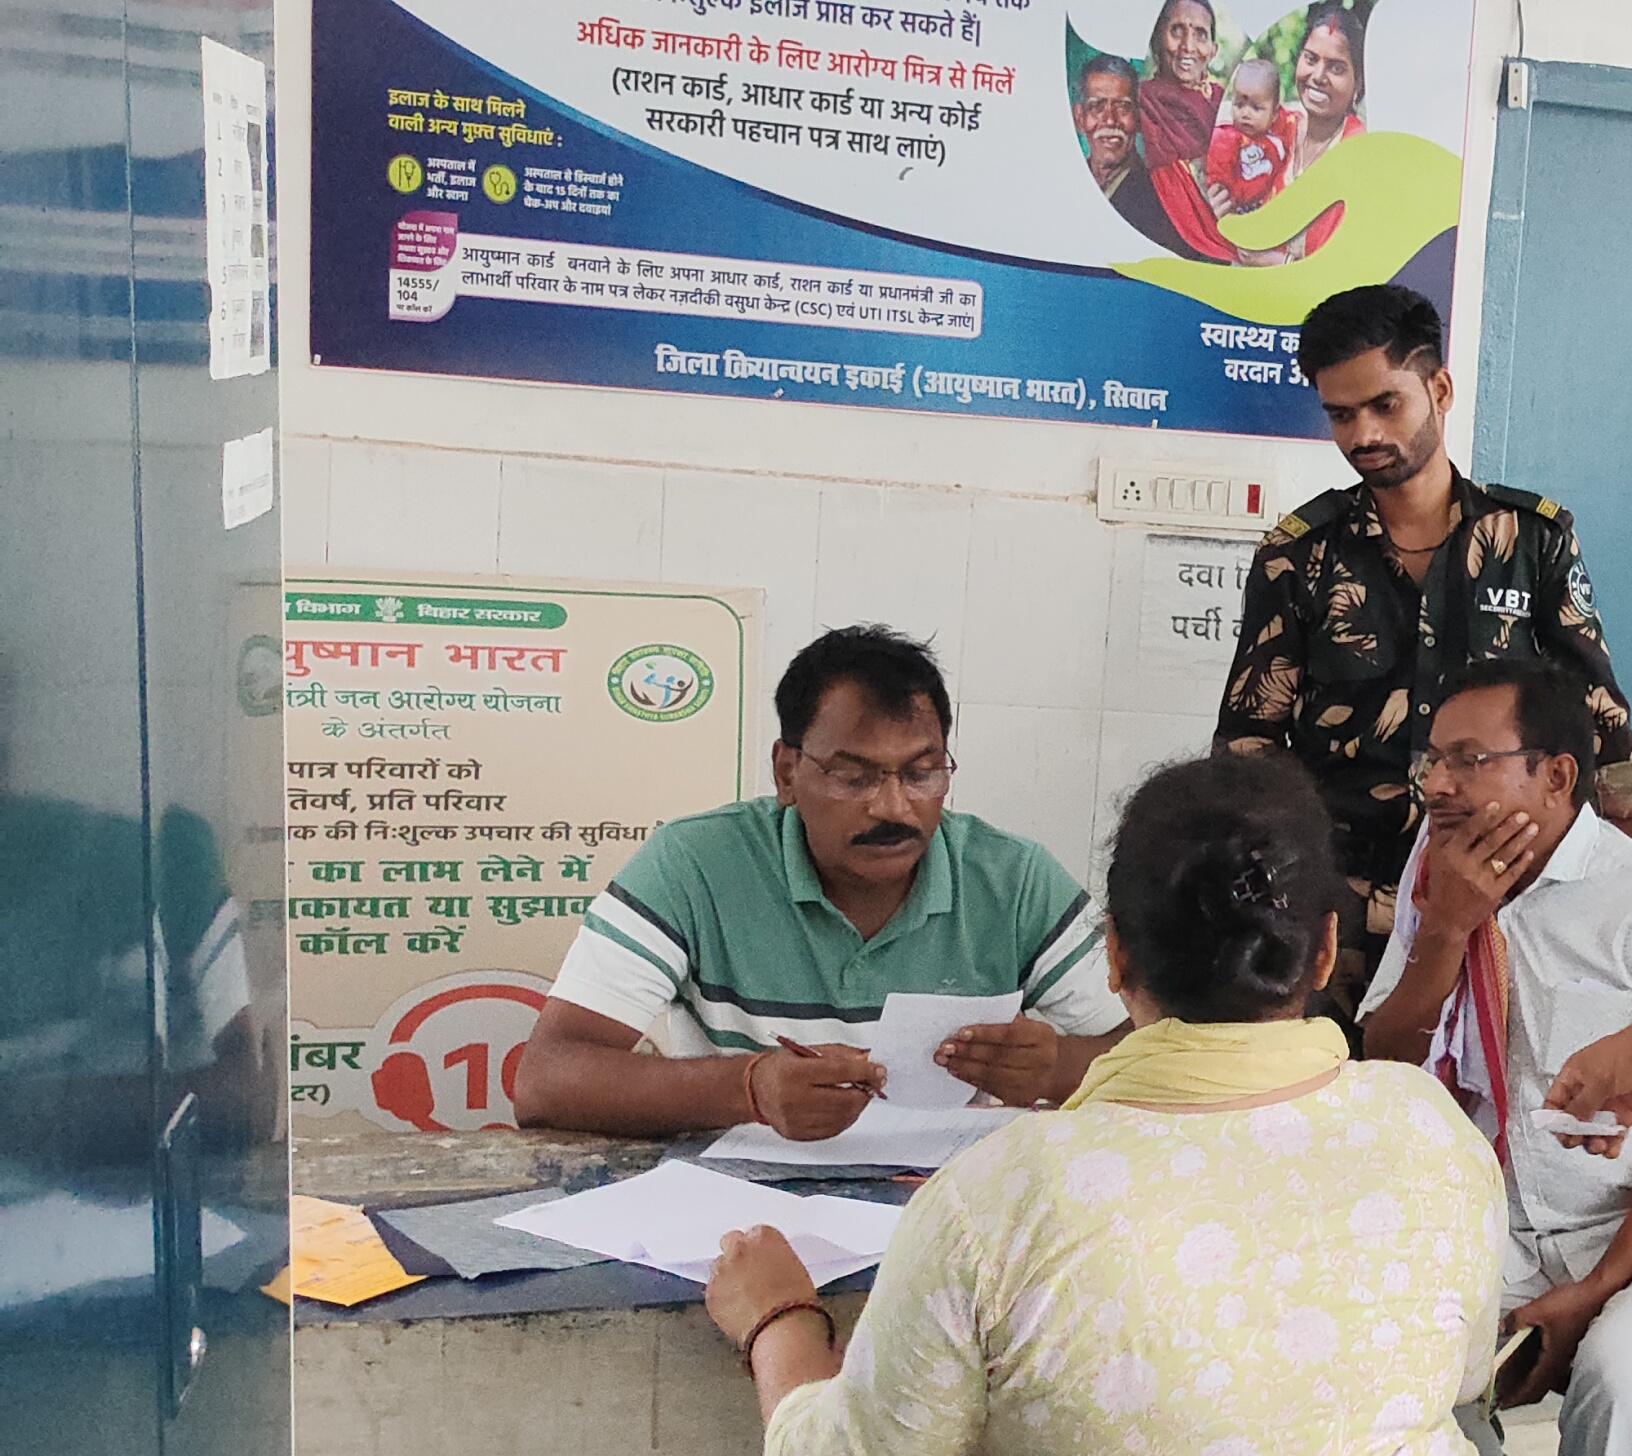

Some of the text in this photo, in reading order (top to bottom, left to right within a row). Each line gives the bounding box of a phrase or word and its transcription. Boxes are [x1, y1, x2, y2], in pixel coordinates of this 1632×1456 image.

[815, 0, 855, 25] प्राप्त
[861, 6, 894, 31] कर
[900, 9, 955, 38] सकते
[576, 16, 1017, 95] अधिक जानकारी के लिए आरोग्य मित्र से मिलें
[388, 88, 527, 119] इलाज के साथ मिलने
[612, 66, 983, 132] (राशन कार्ड, आधार कार्ड या अन्य कोई
[387, 111, 425, 132] वाली
[428, 118, 458, 135] अन्य
[498, 124, 554, 148] सुविधाएं
[645, 107, 946, 168] सरकारी पहचान पत्र साथ लाएं)
[427, 157, 466, 171] अस्पताल
[524, 166, 562, 182] अस्पताल
[450, 174, 476, 188] इलाज
[555, 185, 567, 196] 15
[396, 276, 440, 293] 14555/
[461, 247, 977, 308] आयुष्मान कार्ड बनवाने के लिए अपना आधार कार्ड, राशन कार्ड या प्रधानमंत्री जी का
[396, 289, 418, 302] 104
[461, 270, 512, 289] लाभार्थी
[516, 274, 560, 292] परिवार
[562, 276, 577, 293] के
[581, 281, 604, 295] नाम
[608, 282, 628, 298] पत्र
[633, 282, 672, 302] लेकर
[669, 287, 720, 307] नज़दीकी
[724, 293, 760, 313] वसुधा
[764, 292, 791, 313] केन्द्र
[795, 299, 833, 320] (CSC)
[837, 301, 856, 319] एवं
[859, 305, 882, 321] UTI
[886, 308, 914, 324] ITSL
[918, 307, 944, 327] केन्द्र
[1200, 322, 1278, 353] स्वास्थ्य
[655, 343, 1168, 413] जिला क्रियान्वयन इकाई (आयुष्मान भारत), सिवान
[1224, 357, 1284, 385] वरदान
[1178, 563, 1226, 589] दवा
[295, 599, 361, 616] विभाग
[417, 602, 542, 624] बिहार सरकार
[1486, 587, 1532, 612] VBT
[1171, 606, 1223, 641] पर्ची
[286, 640, 568, 678] युष्मान भारत
[334, 685, 562, 715] जन आरोग्य योजना
[322, 716, 452, 741] के अंतर्गत
[287, 756, 482, 781] पात्र परिवारों को
[366, 787, 508, 814] प्रति परिवार
[288, 825, 318, 841] क
[324, 820, 359, 841] की
[365, 820, 458, 847] निःशुल्क
[464, 826, 534, 843] उपचार
[540, 822, 573, 842] की
[577, 821, 648, 847] सुविधा
[308, 854, 595, 883] का लाभ लेने में
[425, 897, 473, 919] या
[295, 925, 467, 955] कॉल करें
